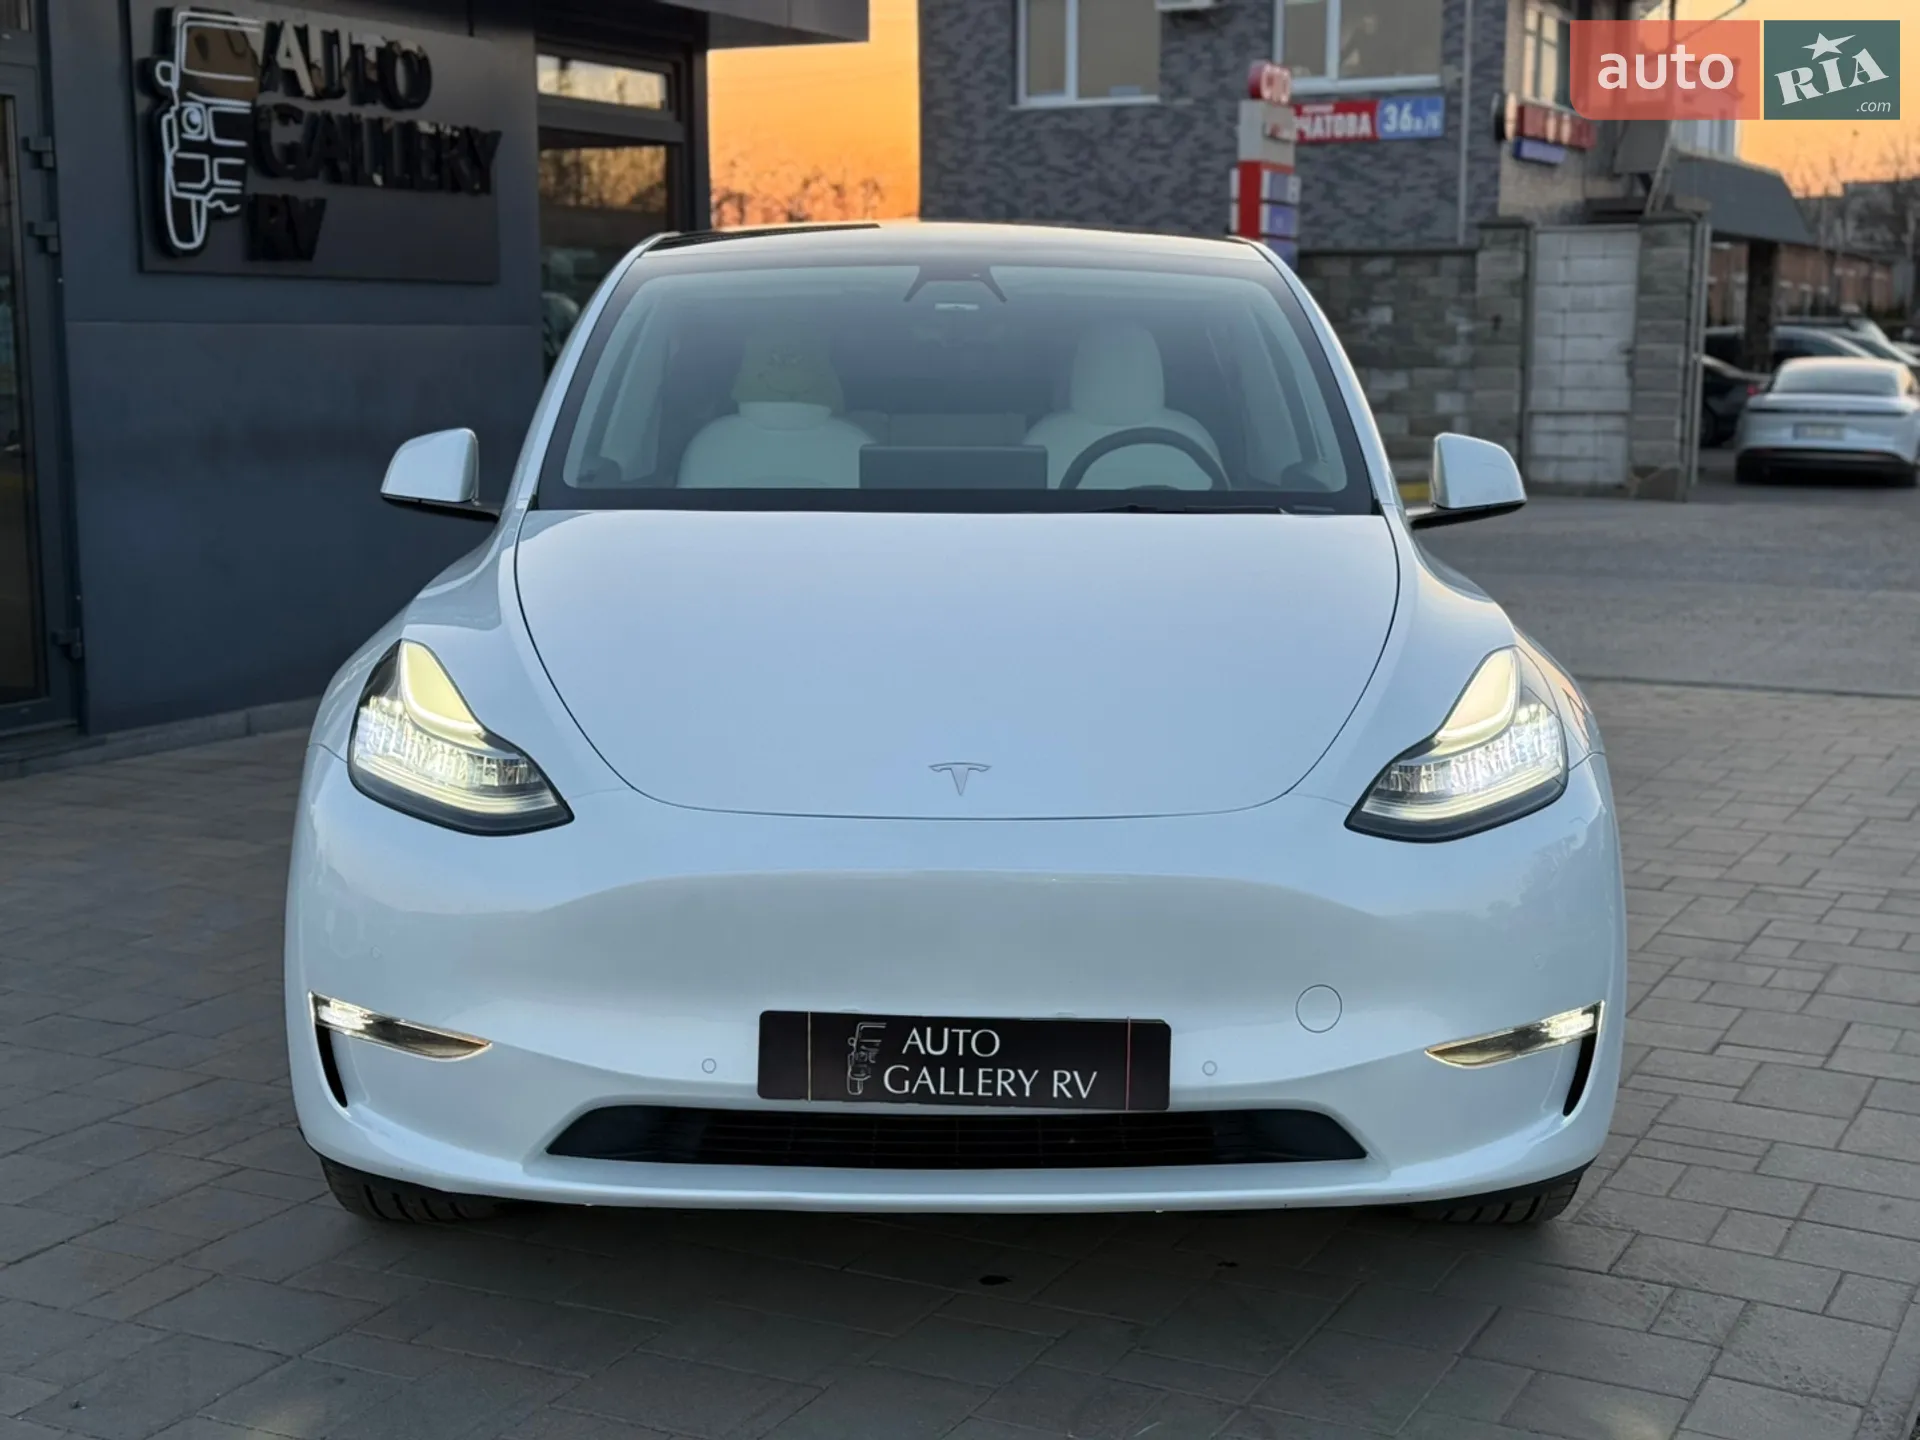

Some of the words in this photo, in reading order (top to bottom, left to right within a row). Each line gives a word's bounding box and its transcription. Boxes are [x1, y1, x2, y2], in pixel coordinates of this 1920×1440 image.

[262, 20, 432, 110] AUTO
[254, 102, 502, 194] GALLERY
[902, 1027, 1000, 1057] AUTO
[883, 1065, 1039, 1098] GALLERY
[1052, 1069, 1097, 1099] RV
